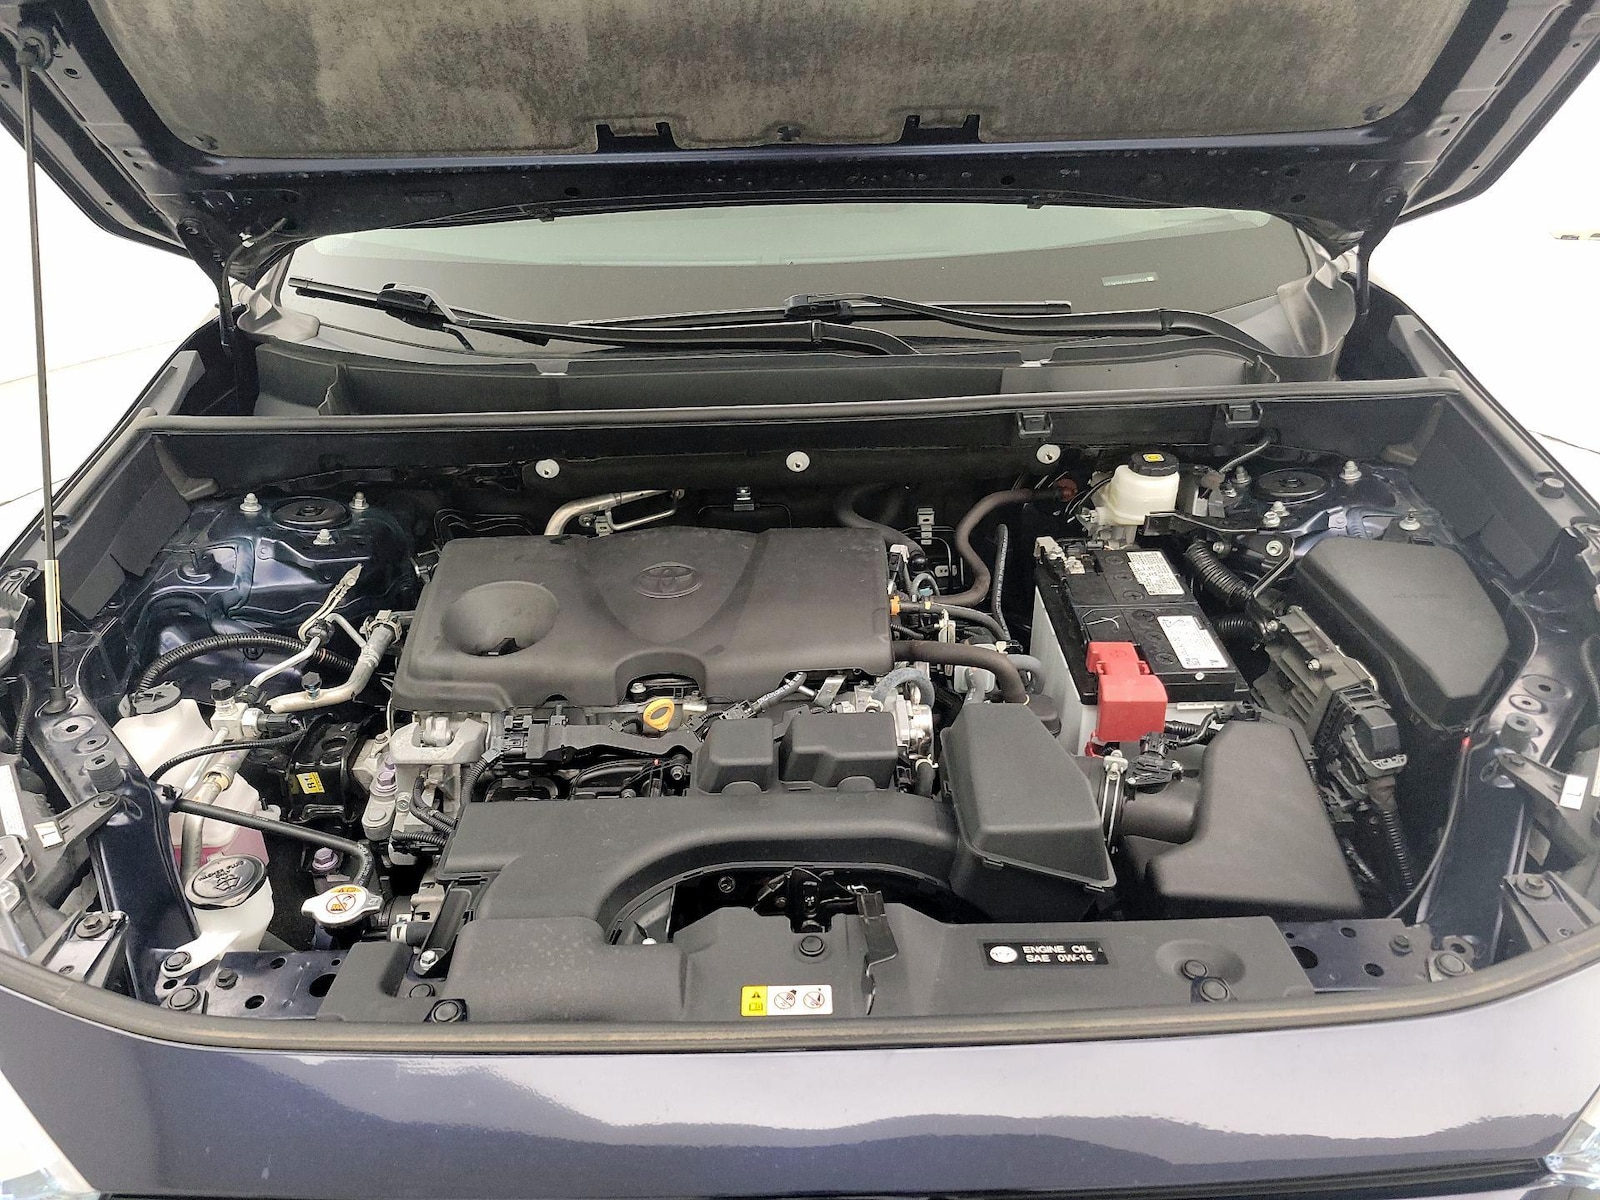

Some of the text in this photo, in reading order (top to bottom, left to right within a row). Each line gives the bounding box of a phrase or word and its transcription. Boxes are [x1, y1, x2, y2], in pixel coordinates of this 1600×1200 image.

[1022, 945, 1092, 953] ENGINE OIL
[1025, 954, 1095, 962] SAE 0W-16
